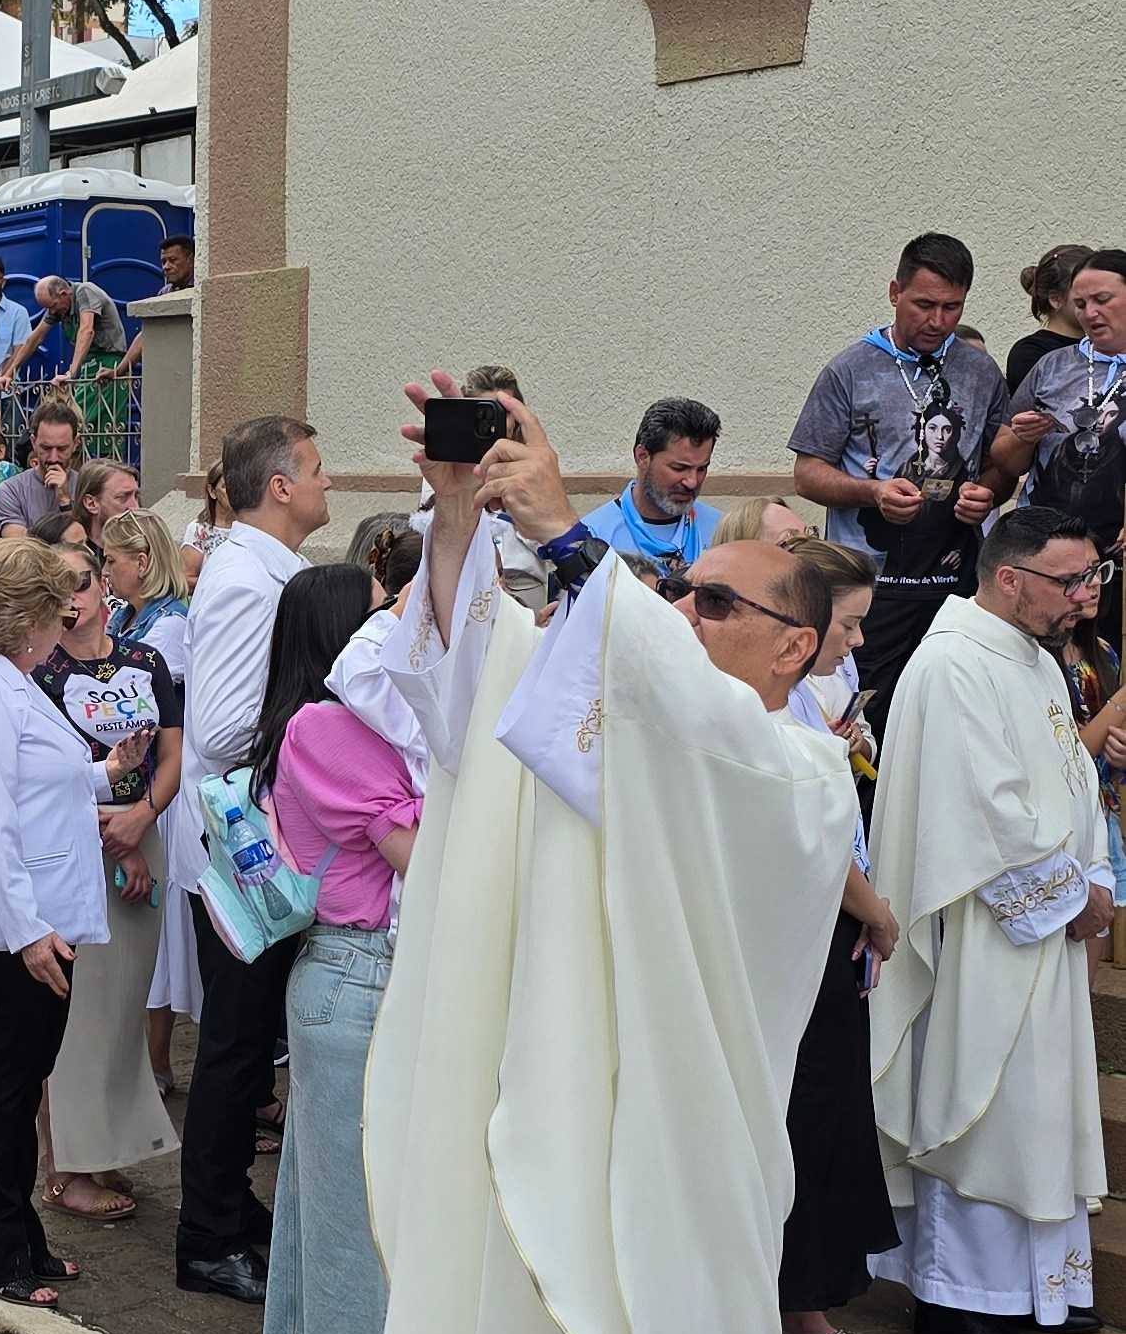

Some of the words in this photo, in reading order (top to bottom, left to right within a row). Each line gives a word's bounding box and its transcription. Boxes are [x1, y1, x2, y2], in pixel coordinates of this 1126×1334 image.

[22, 92, 33, 105] EM
[899, 576, 920, 584] Rosa
[922, 576, 931, 584] de
[932, 575, 959, 584] Viterbo
[87, 684, 139, 704] SOU
[84, 697, 155, 720] PEÇA
[95, 721, 124, 733] DESTE
